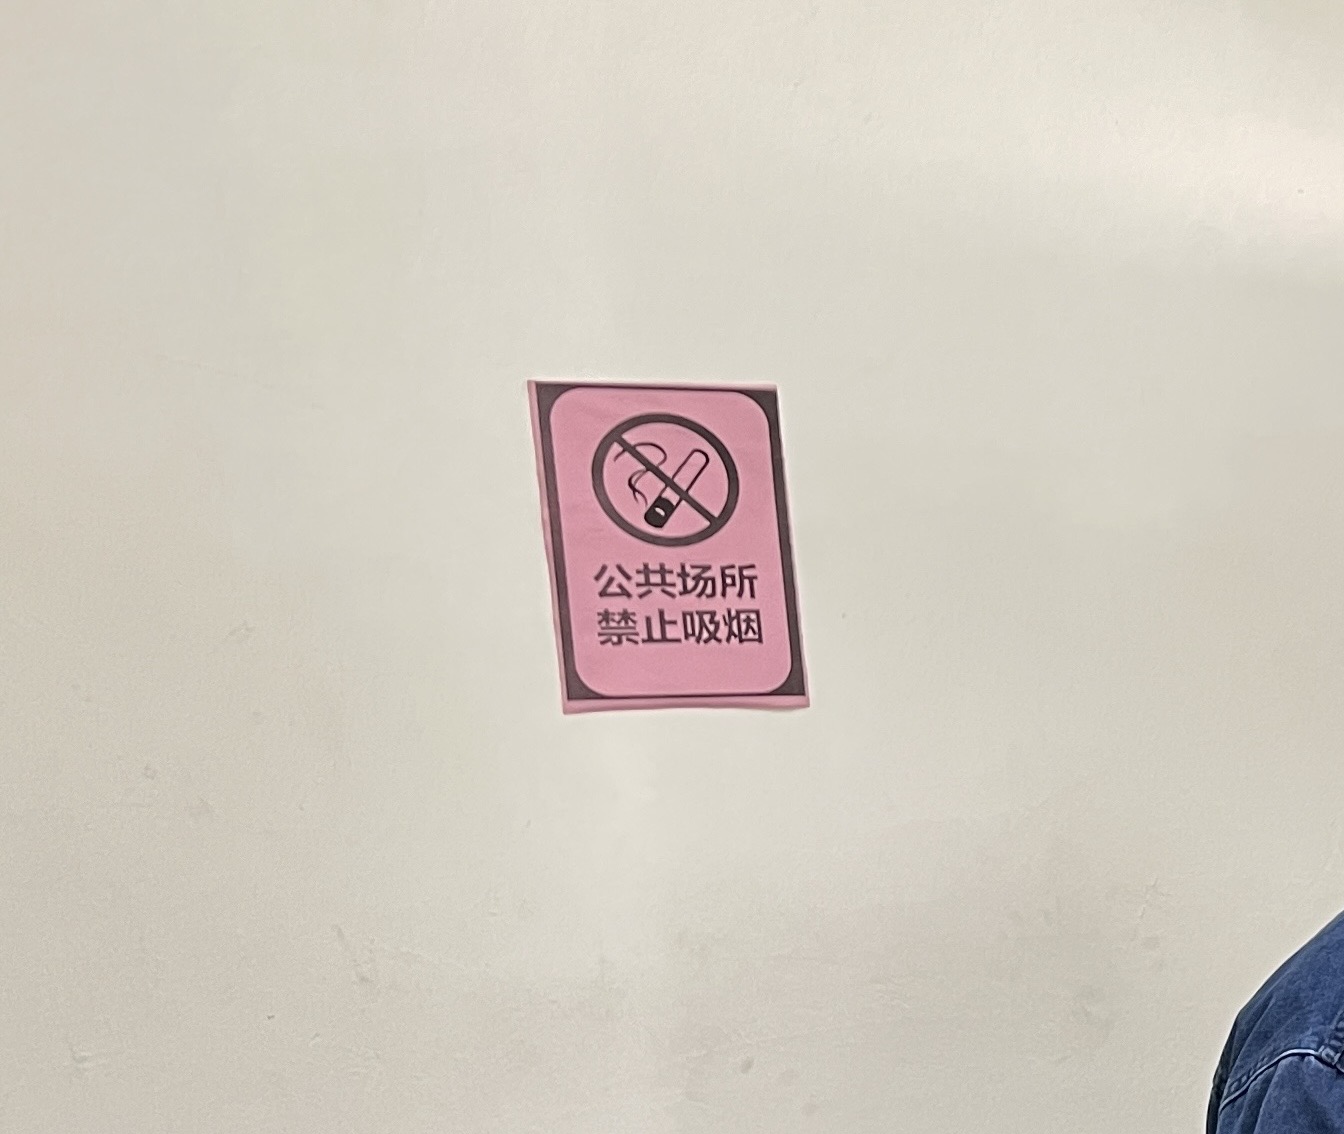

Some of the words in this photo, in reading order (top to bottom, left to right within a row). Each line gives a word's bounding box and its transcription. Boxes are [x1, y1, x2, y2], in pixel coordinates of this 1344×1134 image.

[594, 563, 758, 600] 公共场所
[597, 607, 764, 646] 禁止吸烟
